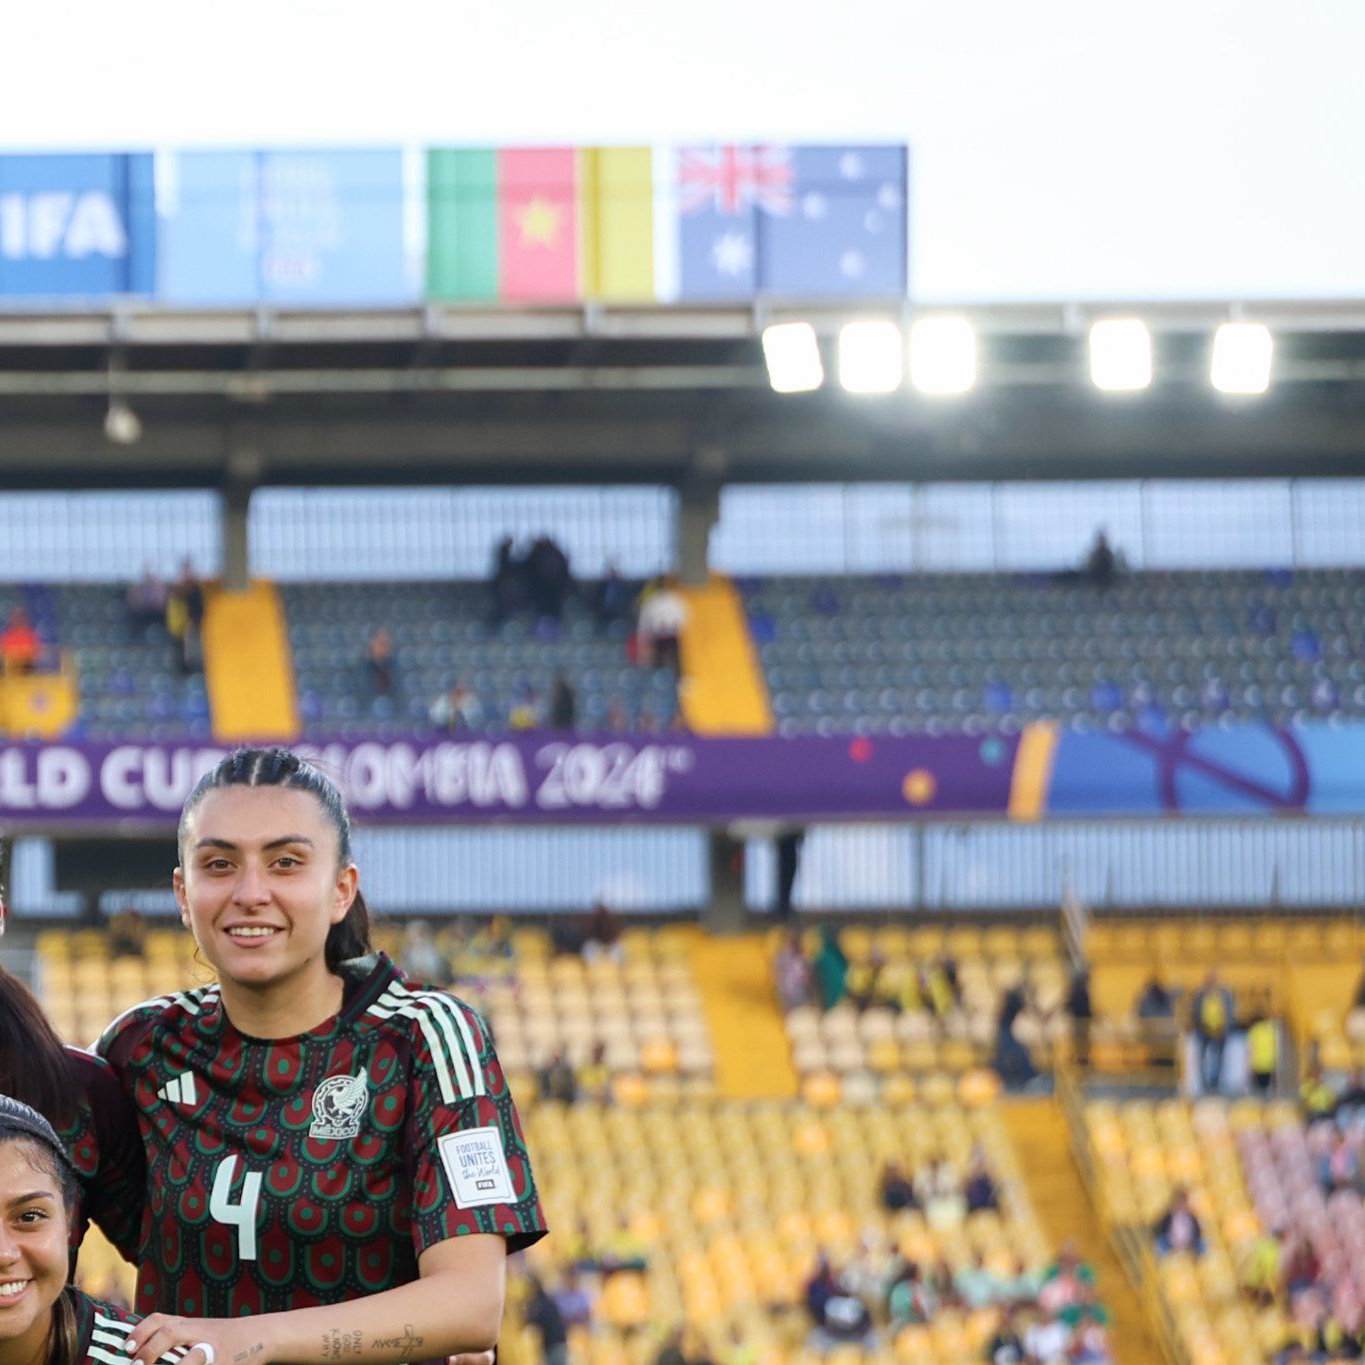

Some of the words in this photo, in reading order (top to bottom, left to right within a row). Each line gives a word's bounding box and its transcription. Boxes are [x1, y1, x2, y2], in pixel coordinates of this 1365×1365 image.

[455, 1140, 493, 1155] FOOTBALL
[459, 1151, 497, 1168] UNITES
[208, 1154, 262, 1261] 4
